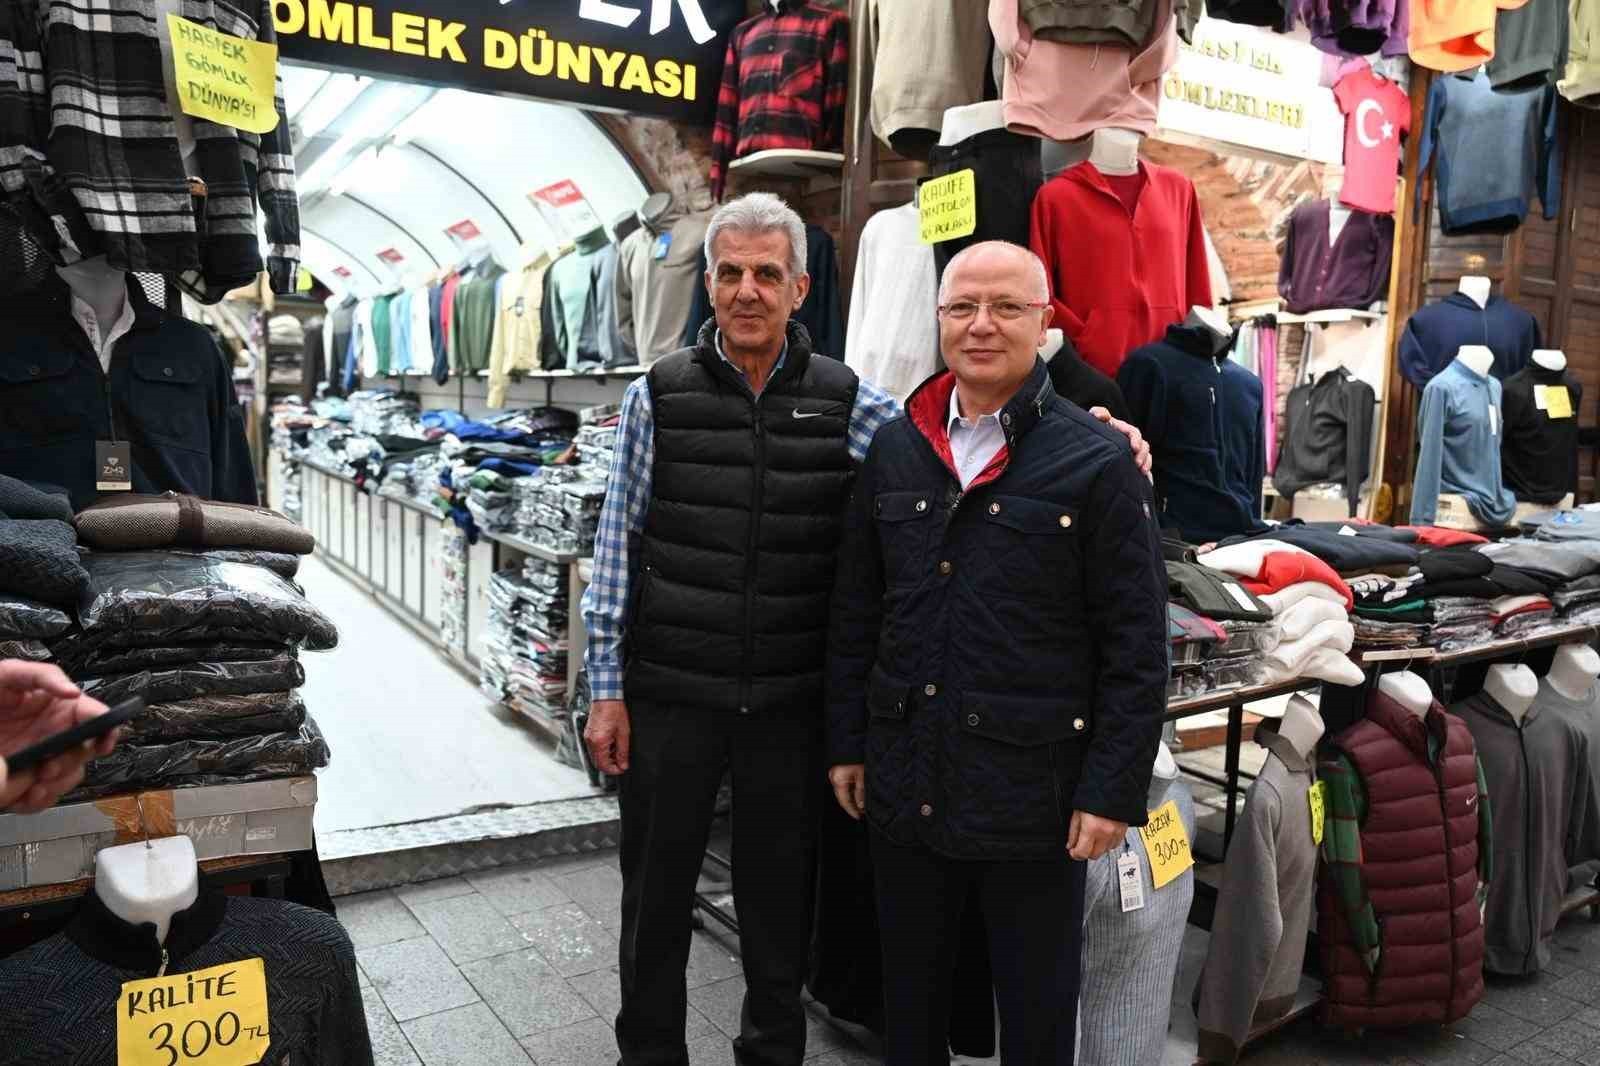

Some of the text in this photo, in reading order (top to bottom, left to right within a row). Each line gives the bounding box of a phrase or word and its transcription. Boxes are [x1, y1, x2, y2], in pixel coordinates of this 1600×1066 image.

[483, 27, 697, 101] DÜNYASI
[1143, 808, 1175, 841] KAZAK
[1154, 837, 1179, 867] 300
[128, 969, 237, 1020] KALİTE
[148, 1011, 241, 1066] 300
